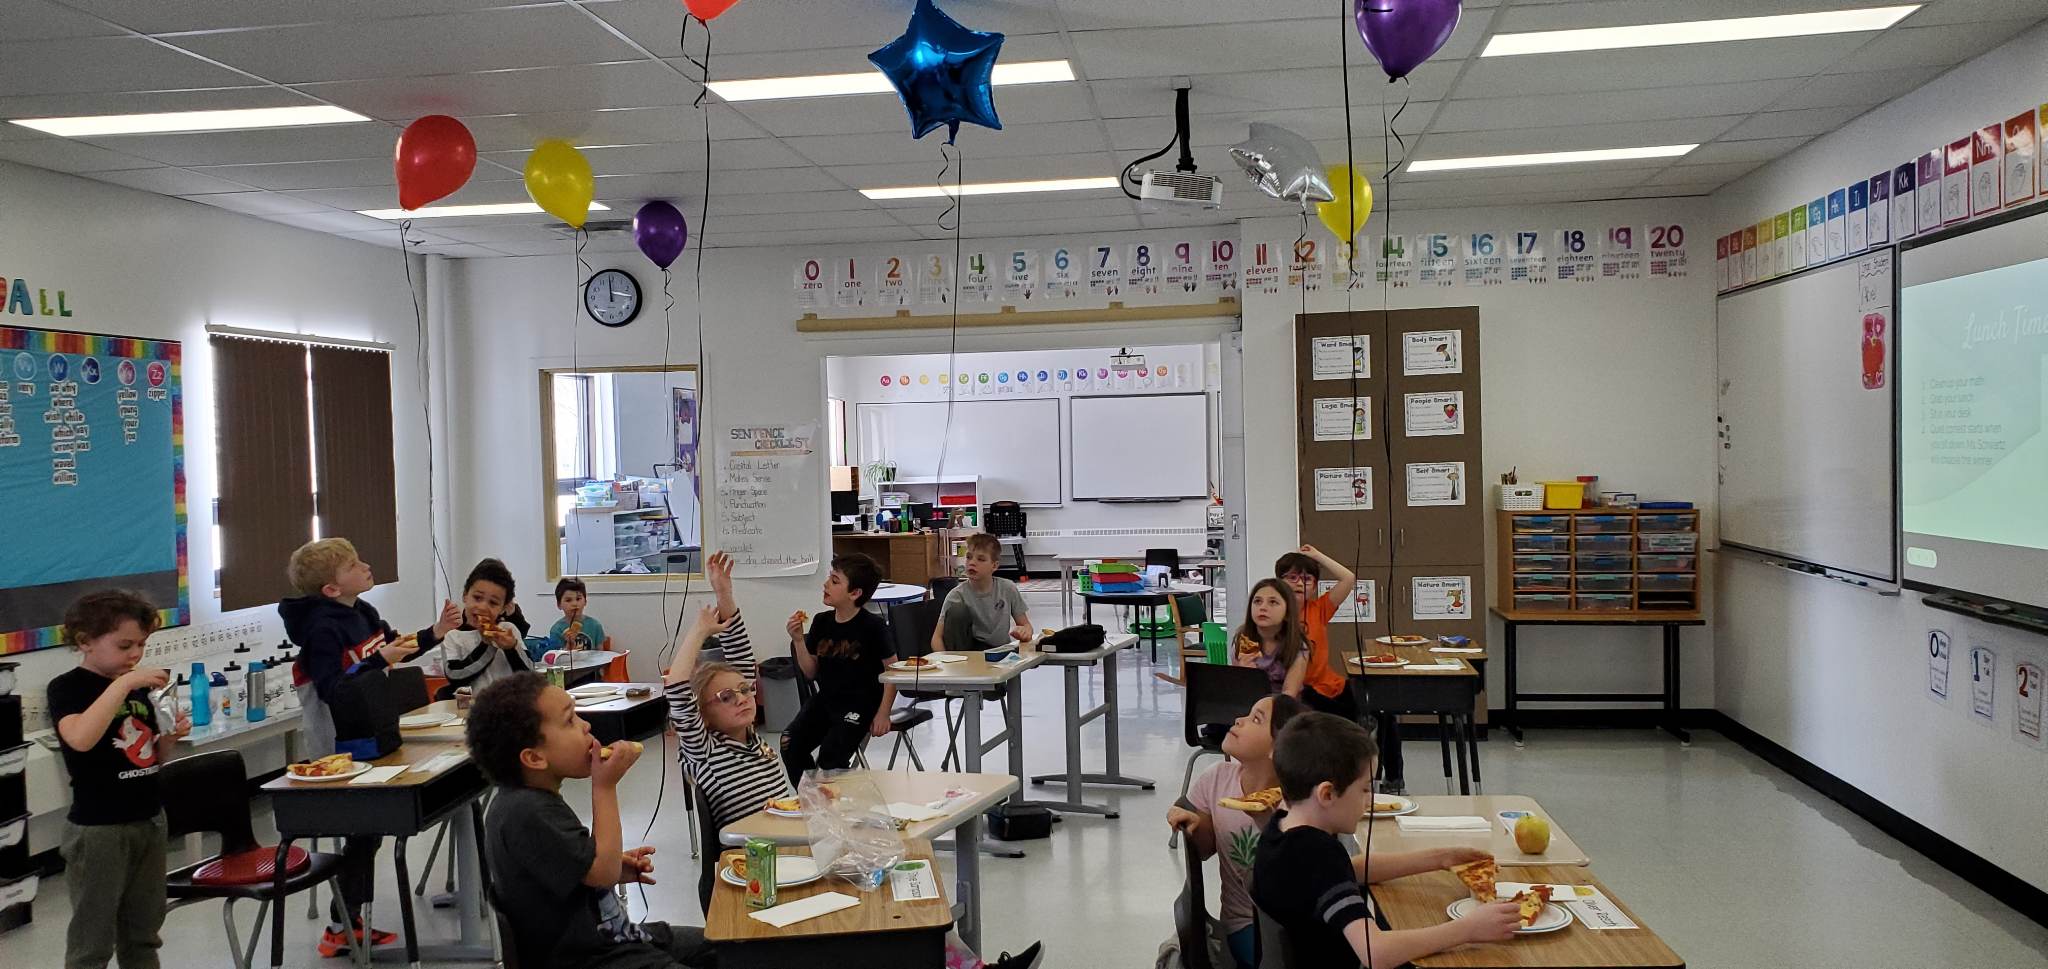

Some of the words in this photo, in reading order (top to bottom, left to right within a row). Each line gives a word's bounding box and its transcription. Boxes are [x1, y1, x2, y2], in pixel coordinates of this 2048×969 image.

[1898, 171, 1909, 189] Kk
[1471, 233, 1494, 256] 16
[1517, 232, 1538, 254] 17
[1564, 230, 1586, 253] 18
[1609, 227, 1632, 250] 19
[1651, 225, 1684, 249] 20
[1174, 242, 1189, 264] 9
[1212, 240, 1234, 263] 10
[1382, 236, 1405, 259] 14
[1428, 234, 1449, 258] 15
[1054, 249, 1069, 270] 6
[1097, 247, 1111, 269] 7
[1136, 245, 1151, 267] 8
[1255, 243, 1269, 266] 11
[1464, 256, 1501, 266] sixteen
[1557, 253, 1594, 265] eighteen
[1650, 249, 1685, 259] twenty
[849, 258, 856, 280] 1
[887, 257, 902, 279] 2
[928, 256, 942, 280] 3
[969, 254, 985, 275] 4
[1012, 251, 1027, 273] 5
[1172, 264, 1193, 273] nine
[1214, 263, 1229, 271] ten
[804, 259, 820, 282] 0
[1091, 269, 1118, 278] seven
[1131, 267, 1156, 279] eight
[1246, 266, 1279, 275] eleven
[844, 280, 862, 288] one
[885, 279, 903, 287] two
[968, 275, 988, 284] four
[1961, 311, 2008, 350] Lunch
[2013, 304, 2048, 345] Time
[1411, 336, 1427, 344] Body
[151, 369, 163, 380] Zz
[118, 389, 137, 401] yellow
[148, 389, 166, 400] zipper
[1321, 402, 1338, 411] Logic
[731, 428, 785, 440] SENTENCE
[755, 437, 810, 450] CHECKLIST
[729, 459, 752, 471] Capital
[757, 460, 781, 471] Letter
[729, 472, 749, 483] Makes
[752, 471, 773, 483] Sense
[751, 485, 769, 498] Space
[729, 498, 767, 510] Punctuation
[730, 511, 755, 528] Subject
[731, 525, 763, 536] Predicate
[1417, 581, 1439, 589] Nature
[1930, 632, 1939, 658] 0
[1973, 650, 1981, 682] 1
[2018, 666, 2029, 698] 2
[118, 766, 160, 780] GHOST
